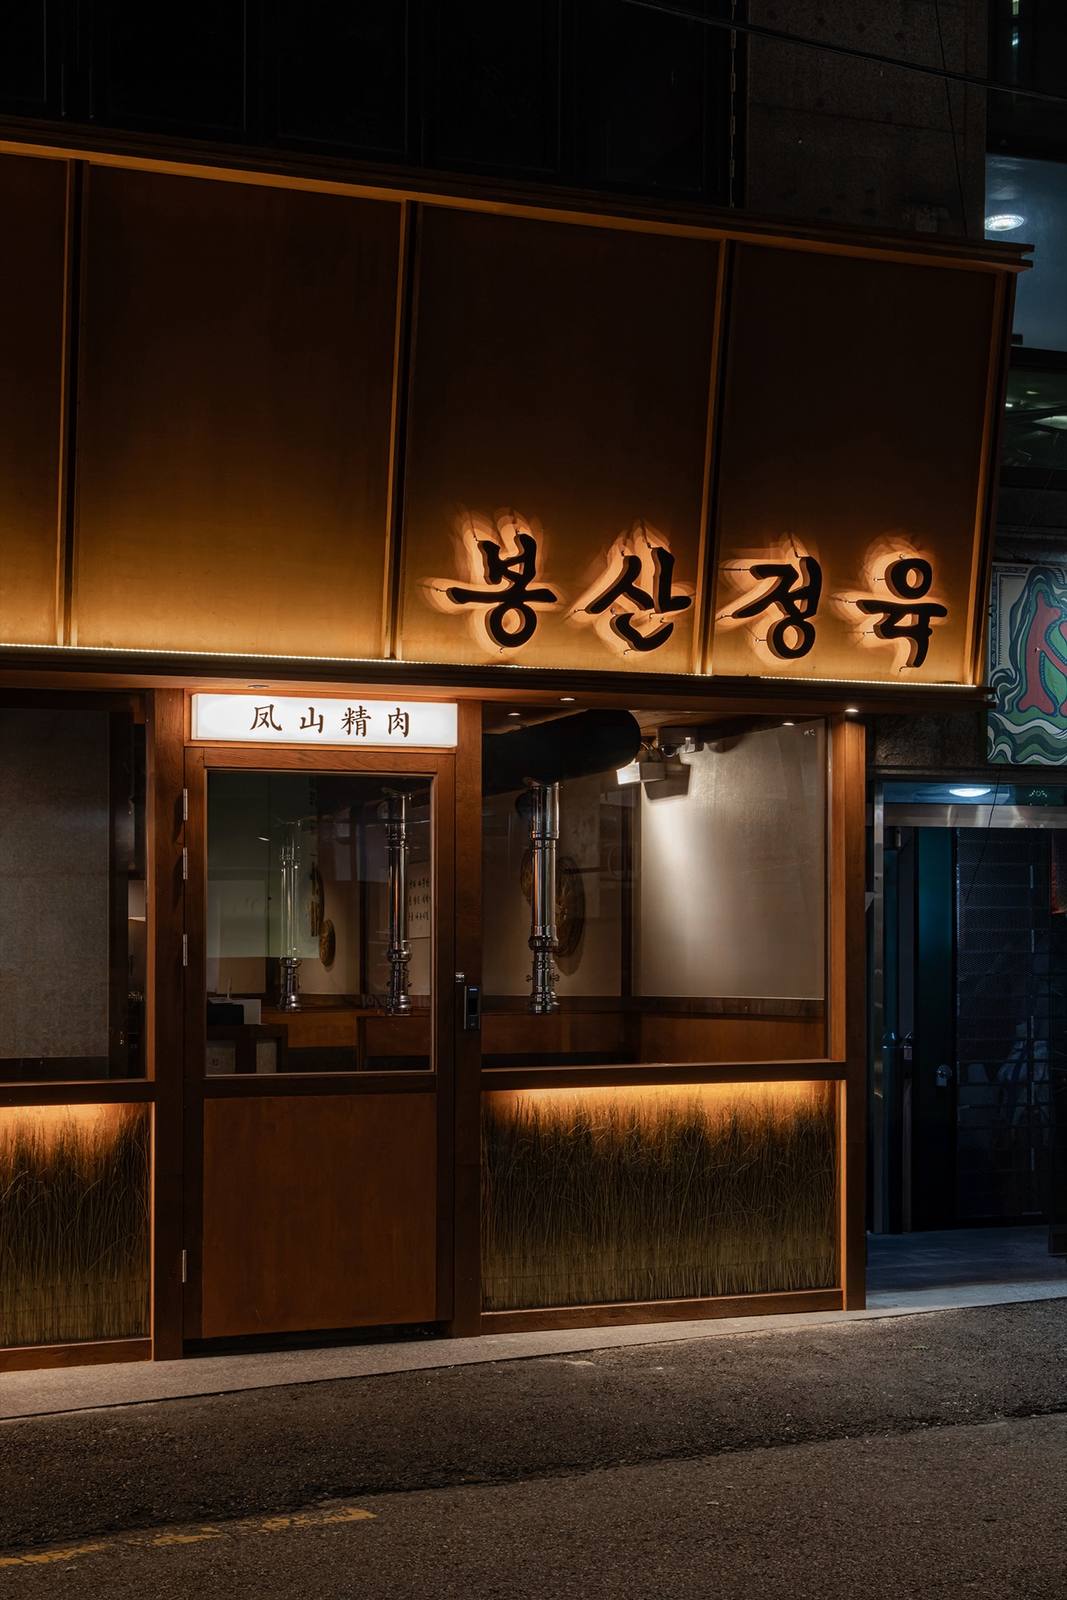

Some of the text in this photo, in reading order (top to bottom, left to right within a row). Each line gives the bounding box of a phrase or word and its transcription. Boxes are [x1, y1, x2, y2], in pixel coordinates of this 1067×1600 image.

[446, 532, 949, 669] 봉산정육
[250, 703, 411, 738] 凤山精肉
